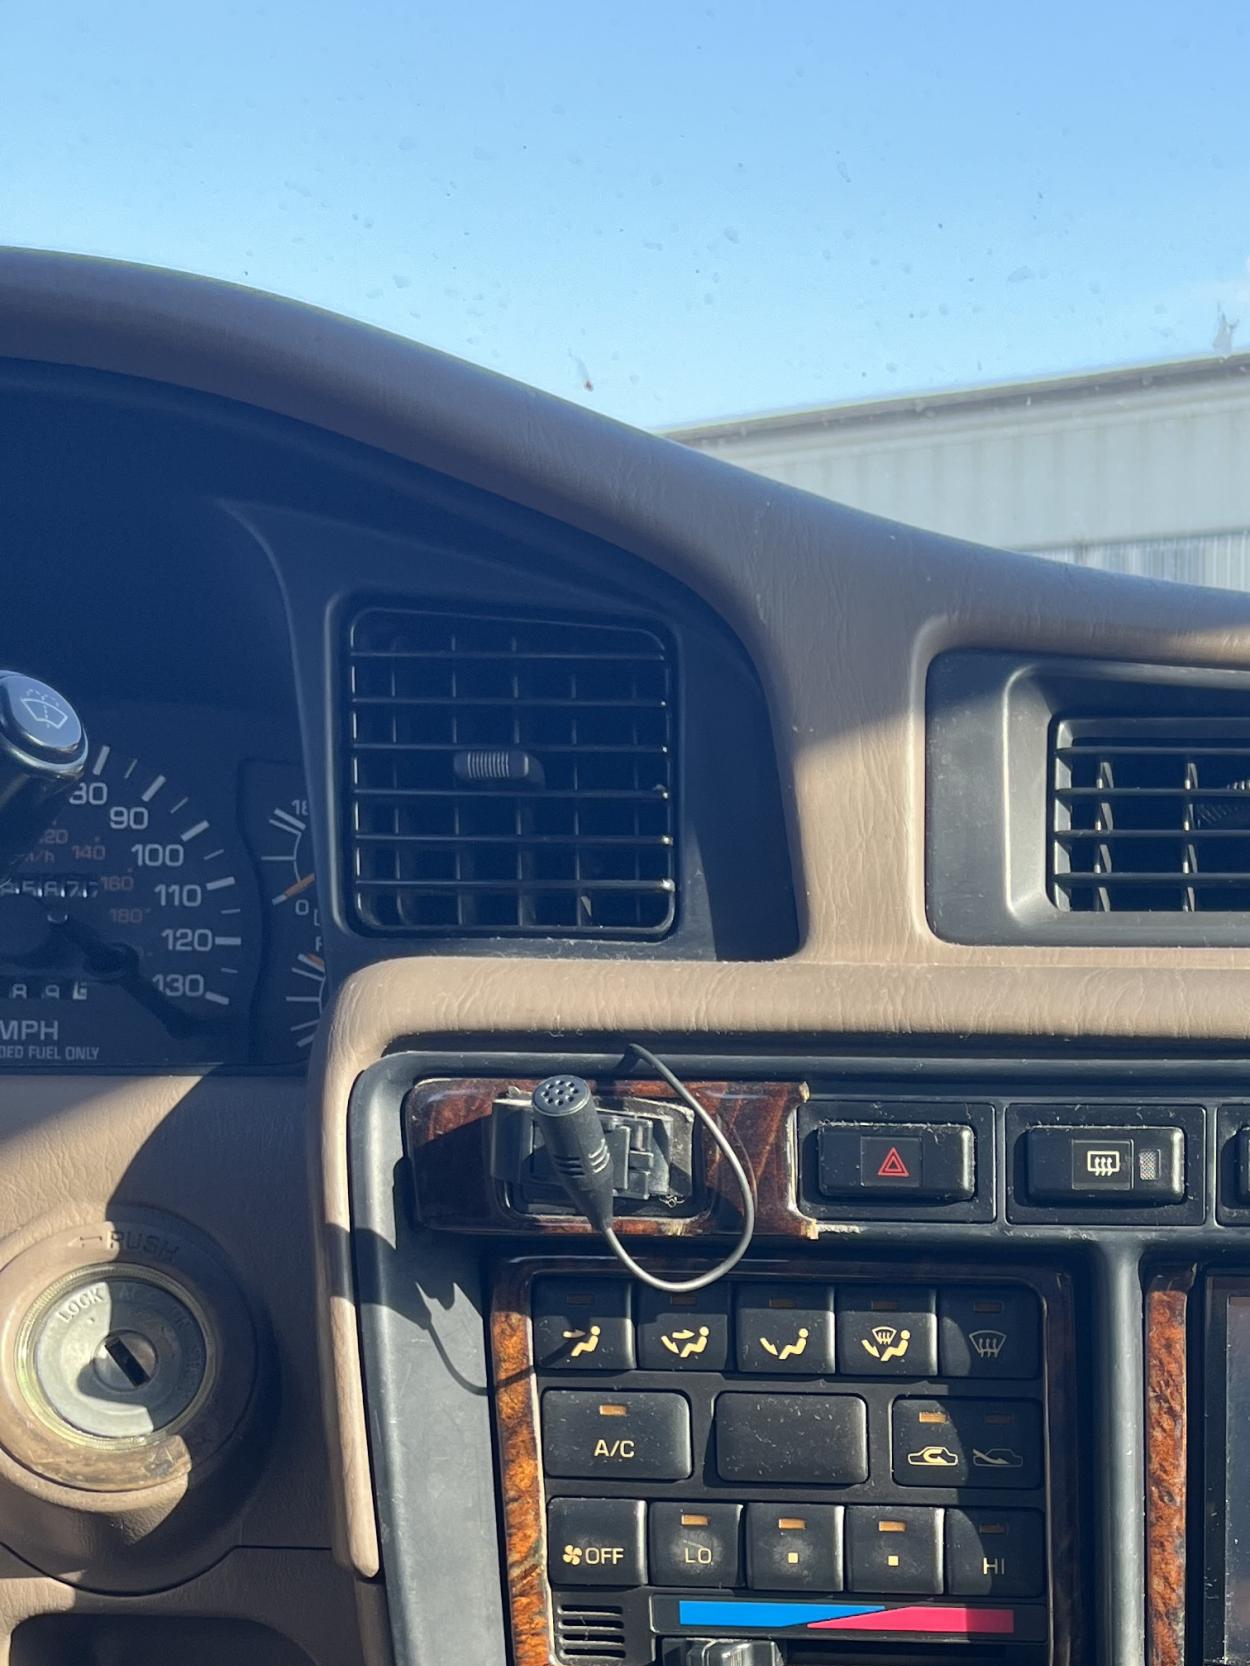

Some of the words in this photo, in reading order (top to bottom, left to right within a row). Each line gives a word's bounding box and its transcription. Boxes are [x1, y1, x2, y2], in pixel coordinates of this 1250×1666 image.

[109, 806, 149, 830] 90
[71, 845, 106, 861] 140
[131, 843, 185, 867] 100
[101, 876, 135, 891] 160
[154, 884, 202, 907] 110
[110, 908, 144, 924] 180
[161, 928, 213, 952] 120
[152, 973, 205, 997] 130
[0, 1019, 59, 1041] MPH
[28, 1045, 62, 1061] FUEL
[65, 1046, 100, 1061] ONLY
[57, 1285, 107, 1324] LOCK
[593, 1439, 635, 1459] A/C
[585, 1547, 625, 1565] OFF
[684, 1547, 713, 1565] LO
[983, 1557, 1006, 1576] HI
